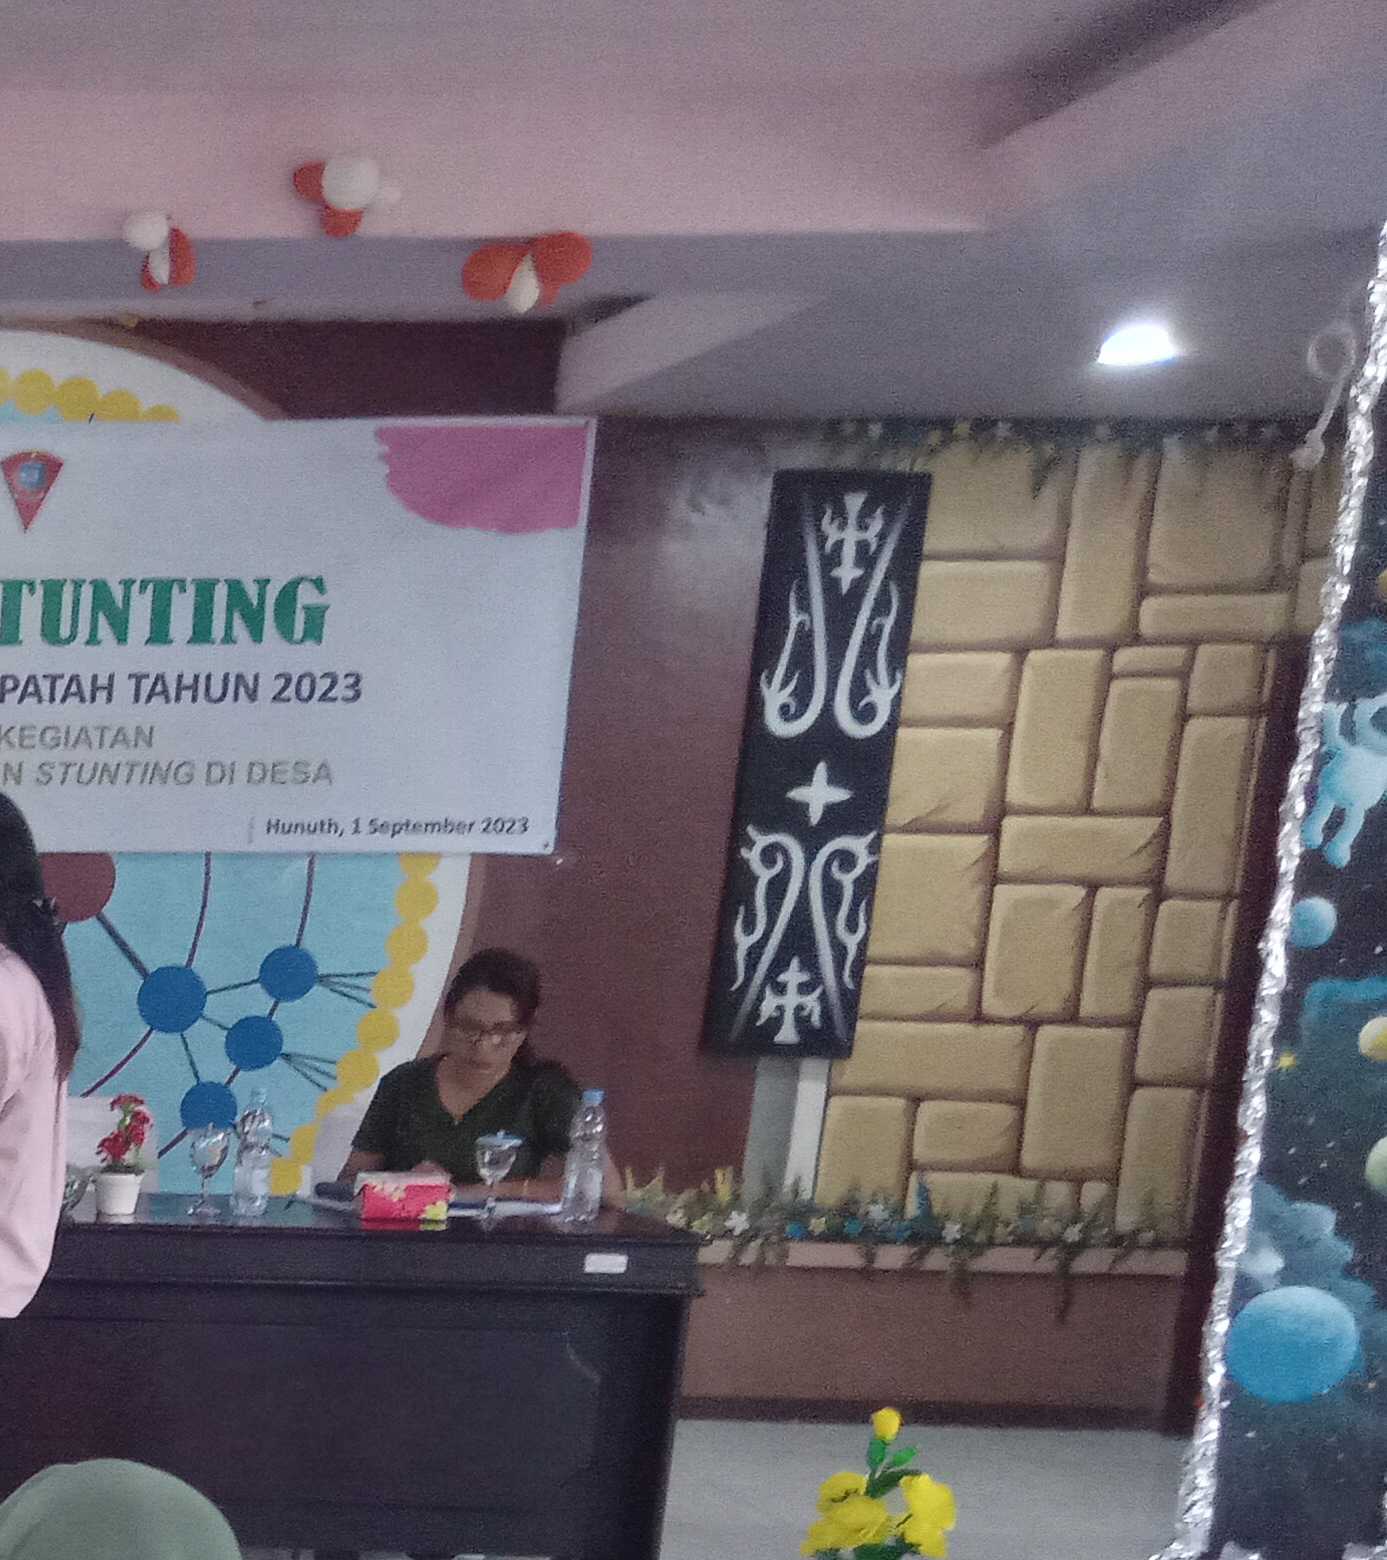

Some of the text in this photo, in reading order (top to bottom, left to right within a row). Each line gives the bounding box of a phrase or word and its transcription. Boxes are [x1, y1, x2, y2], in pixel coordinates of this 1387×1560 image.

[127, 672, 260, 705] TAHUN
[270, 671, 364, 704] 2023
[35, 760, 196, 786] STUNTING
[204, 760, 236, 786] DI
[246, 760, 334, 786] DESA
[265, 815, 530, 839] Hunuth, 1 September 2023
